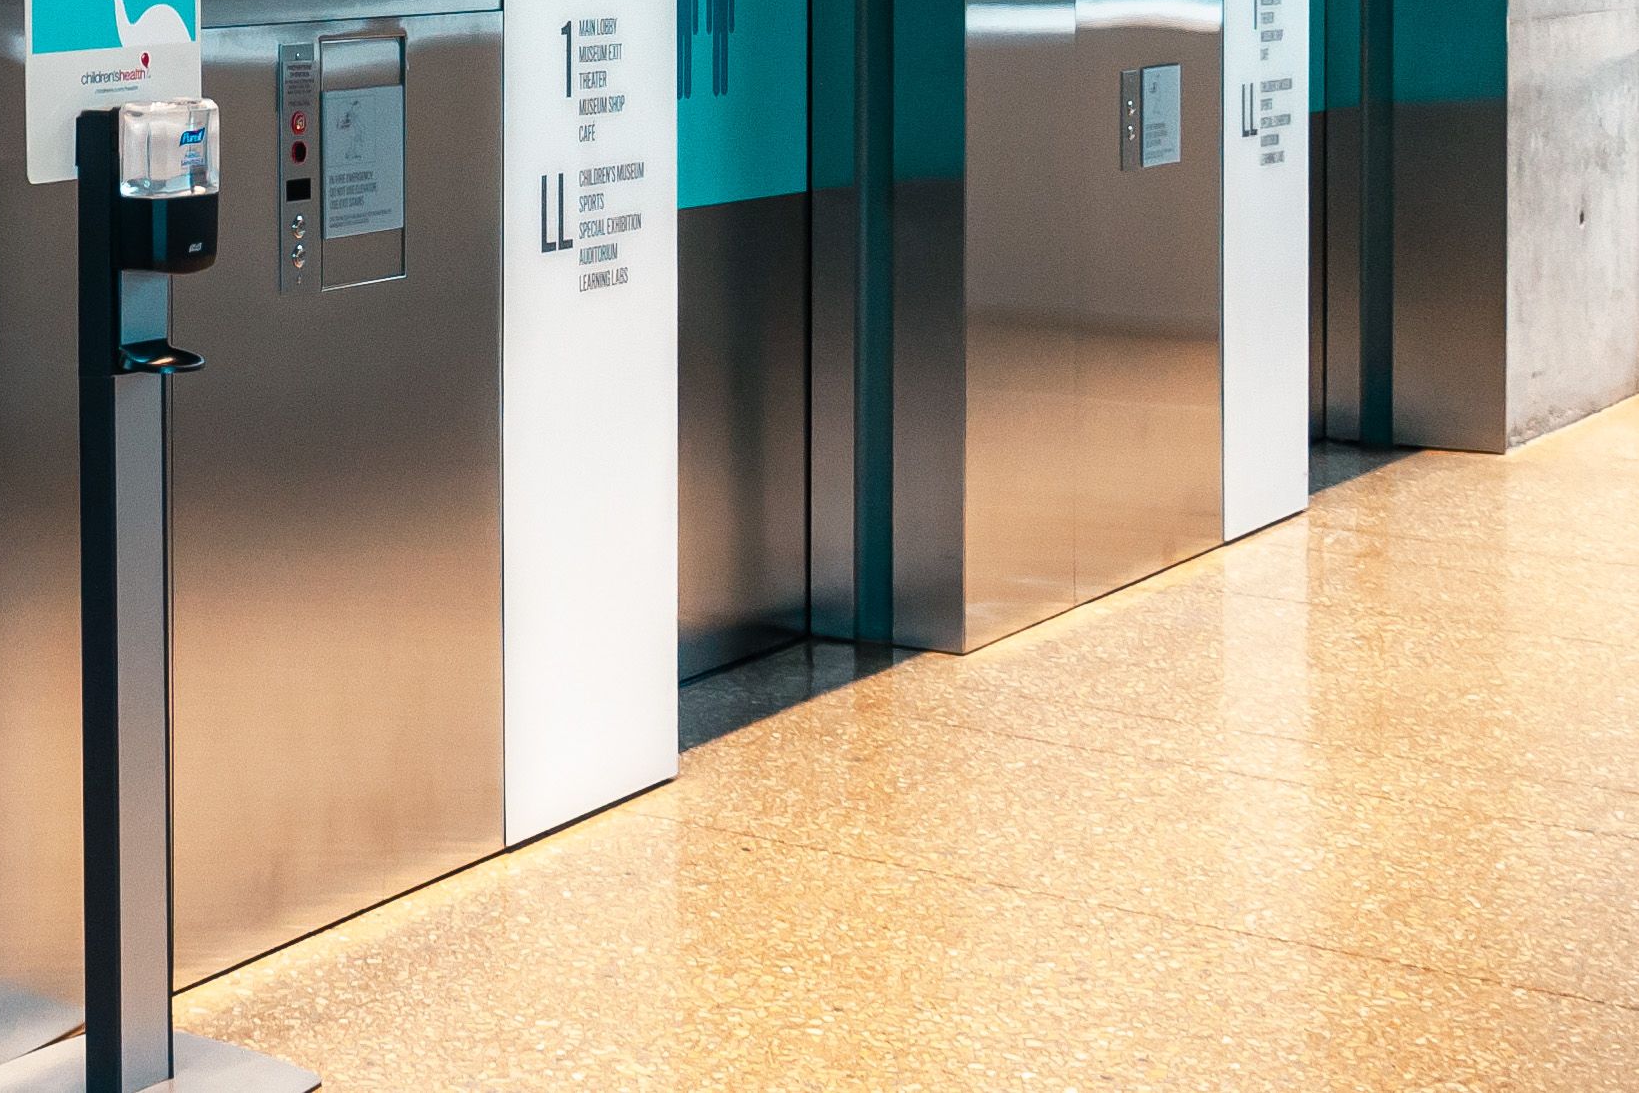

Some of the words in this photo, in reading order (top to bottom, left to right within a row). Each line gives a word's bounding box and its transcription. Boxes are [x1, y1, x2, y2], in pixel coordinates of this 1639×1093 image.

[578, 18, 596, 37] MAIN
[596, 17, 617, 36] LOBBY
[560, 20, 572, 98] 1
[578, 43, 608, 63] MUSEUM
[608, 42, 623, 61] EXIT
[578, 70, 607, 90] THEATER
[578, 97, 608, 116] MUSEUM
[608, 94, 625, 114] SHOP
[1241, 82, 1258, 138] LL
[578, 121, 596, 143] CAFÉ
[616, 161, 645, 182] MUSEUM
[541, 173, 573, 253] LL
[578, 193, 604, 213] SPORTS
[578, 219, 606, 240] SPECIAL
[606, 212, 642, 236] EXHIBITION
[578, 242, 618, 266] AUDITORIUM
[578, 270, 610, 293] LEARNING
[611, 266, 629, 286] LABS
